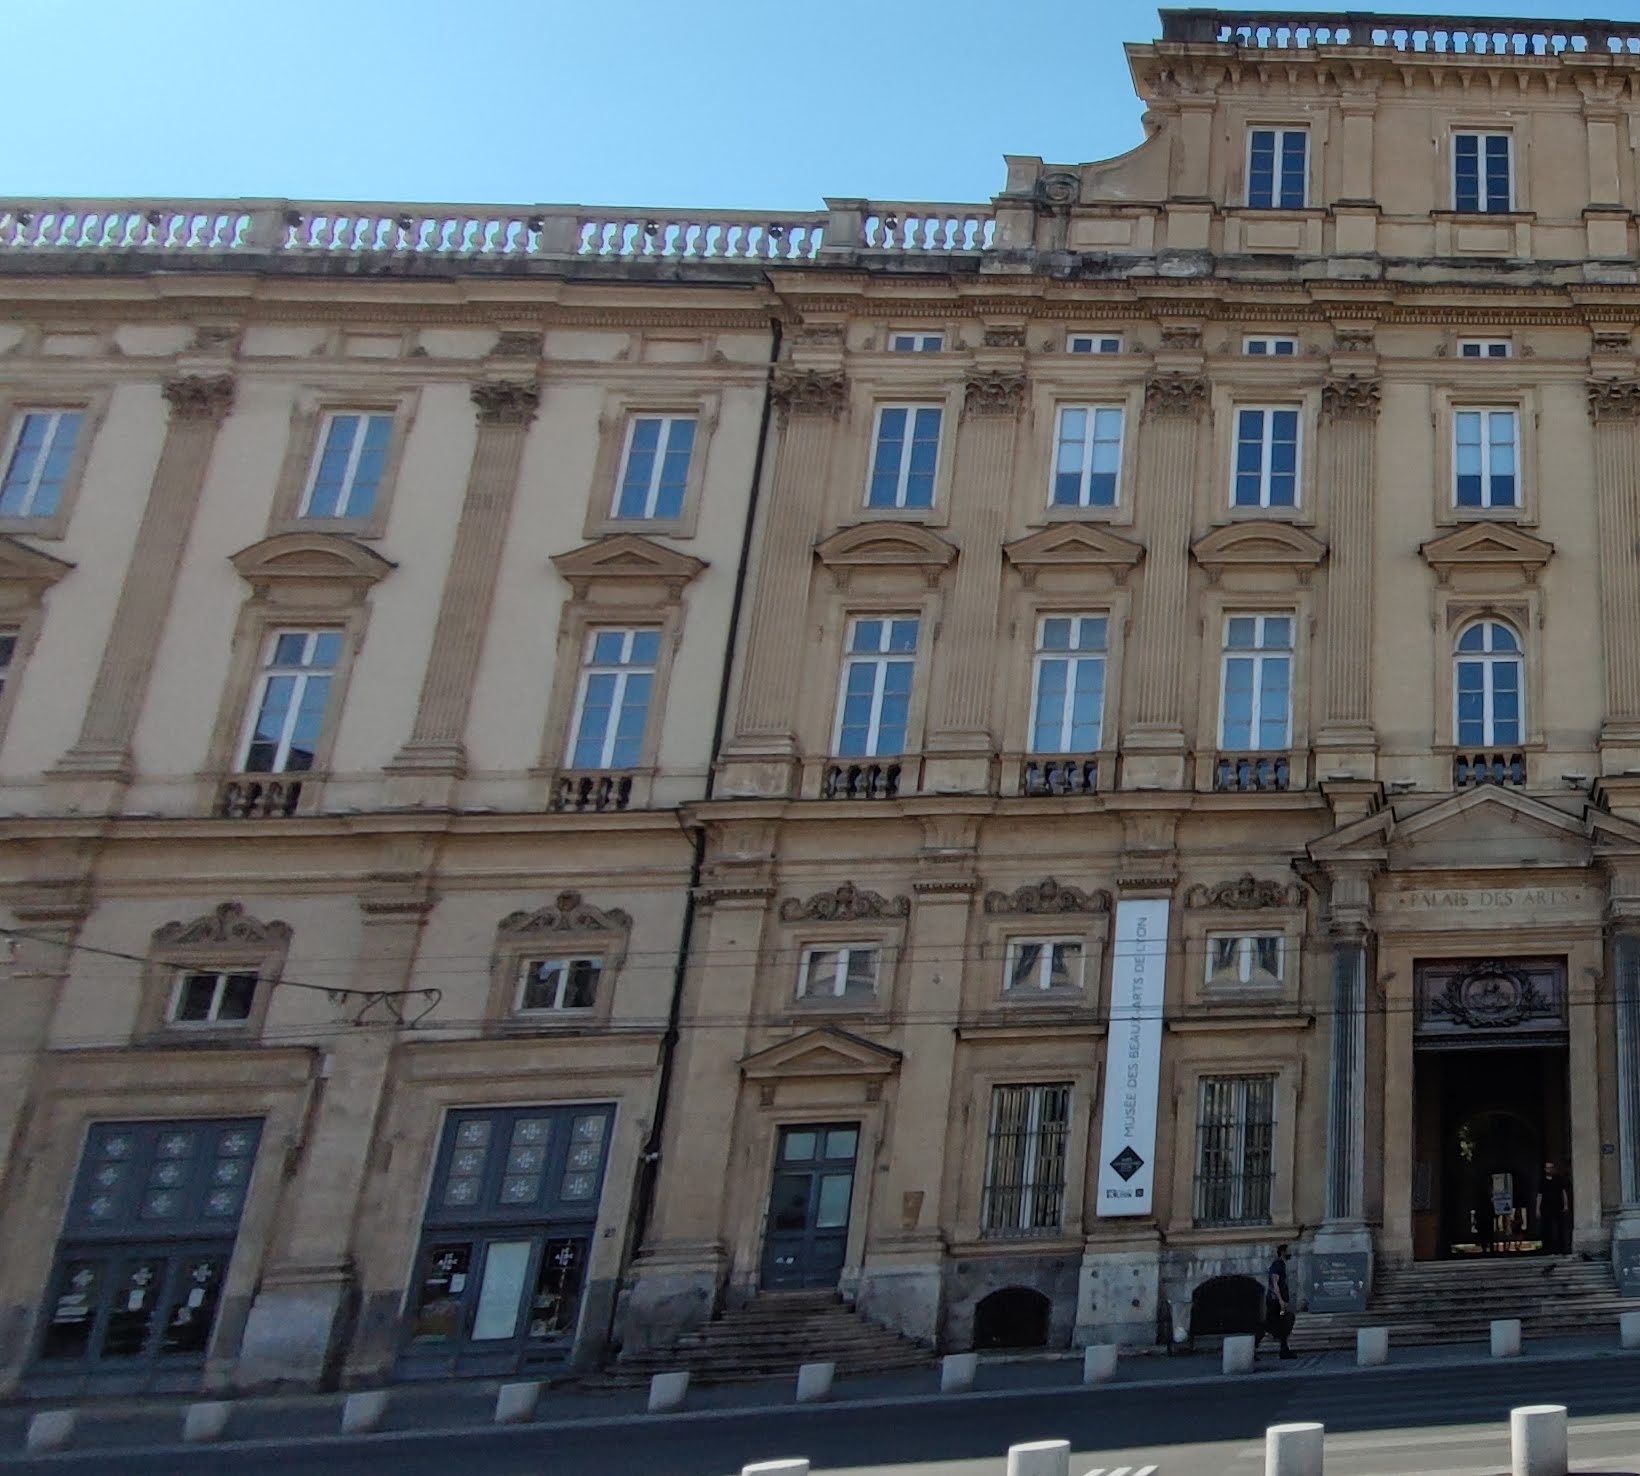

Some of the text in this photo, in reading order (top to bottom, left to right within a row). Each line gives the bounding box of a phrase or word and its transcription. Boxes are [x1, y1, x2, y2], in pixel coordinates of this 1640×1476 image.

[1410, 890, 1569, 907] PALAIS DES ARTS
[1124, 916, 1148, 1137] MUSÉE DES BEAUX-ARTS DE LYON
